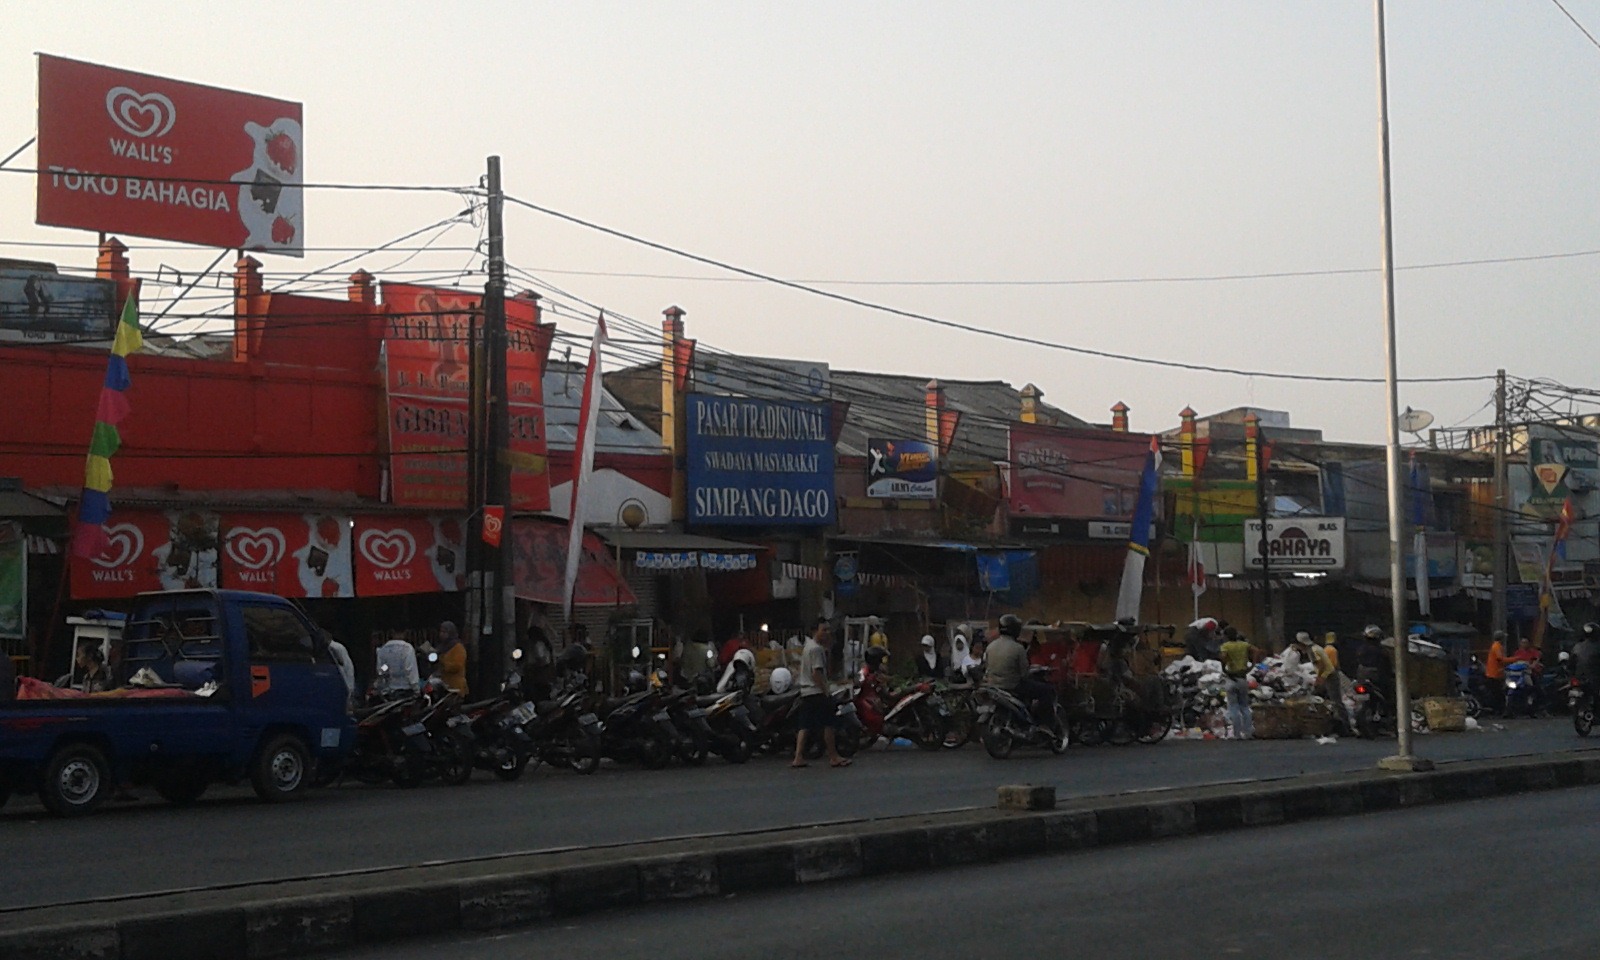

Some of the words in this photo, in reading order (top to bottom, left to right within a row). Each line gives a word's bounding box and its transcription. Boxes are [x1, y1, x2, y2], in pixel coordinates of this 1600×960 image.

[110, 137, 172, 164] WALL'S
[48, 165, 119, 196] TOKO
[125, 178, 230, 212] BAHAGIA
[696, 400, 740, 437] PASAR
[742, 404, 826, 441] TRADISIONAL
[704, 450, 754, 471] SWADAYA
[754, 452, 819, 473] MASYARAKAT
[695, 486, 777, 518] SIMPANG
[779, 488, 830, 518] DAGO
[1258, 538, 1331, 556] CAHAYA
[91, 568, 135, 582] WALL'S
[373, 568, 412, 581] WALL'S
